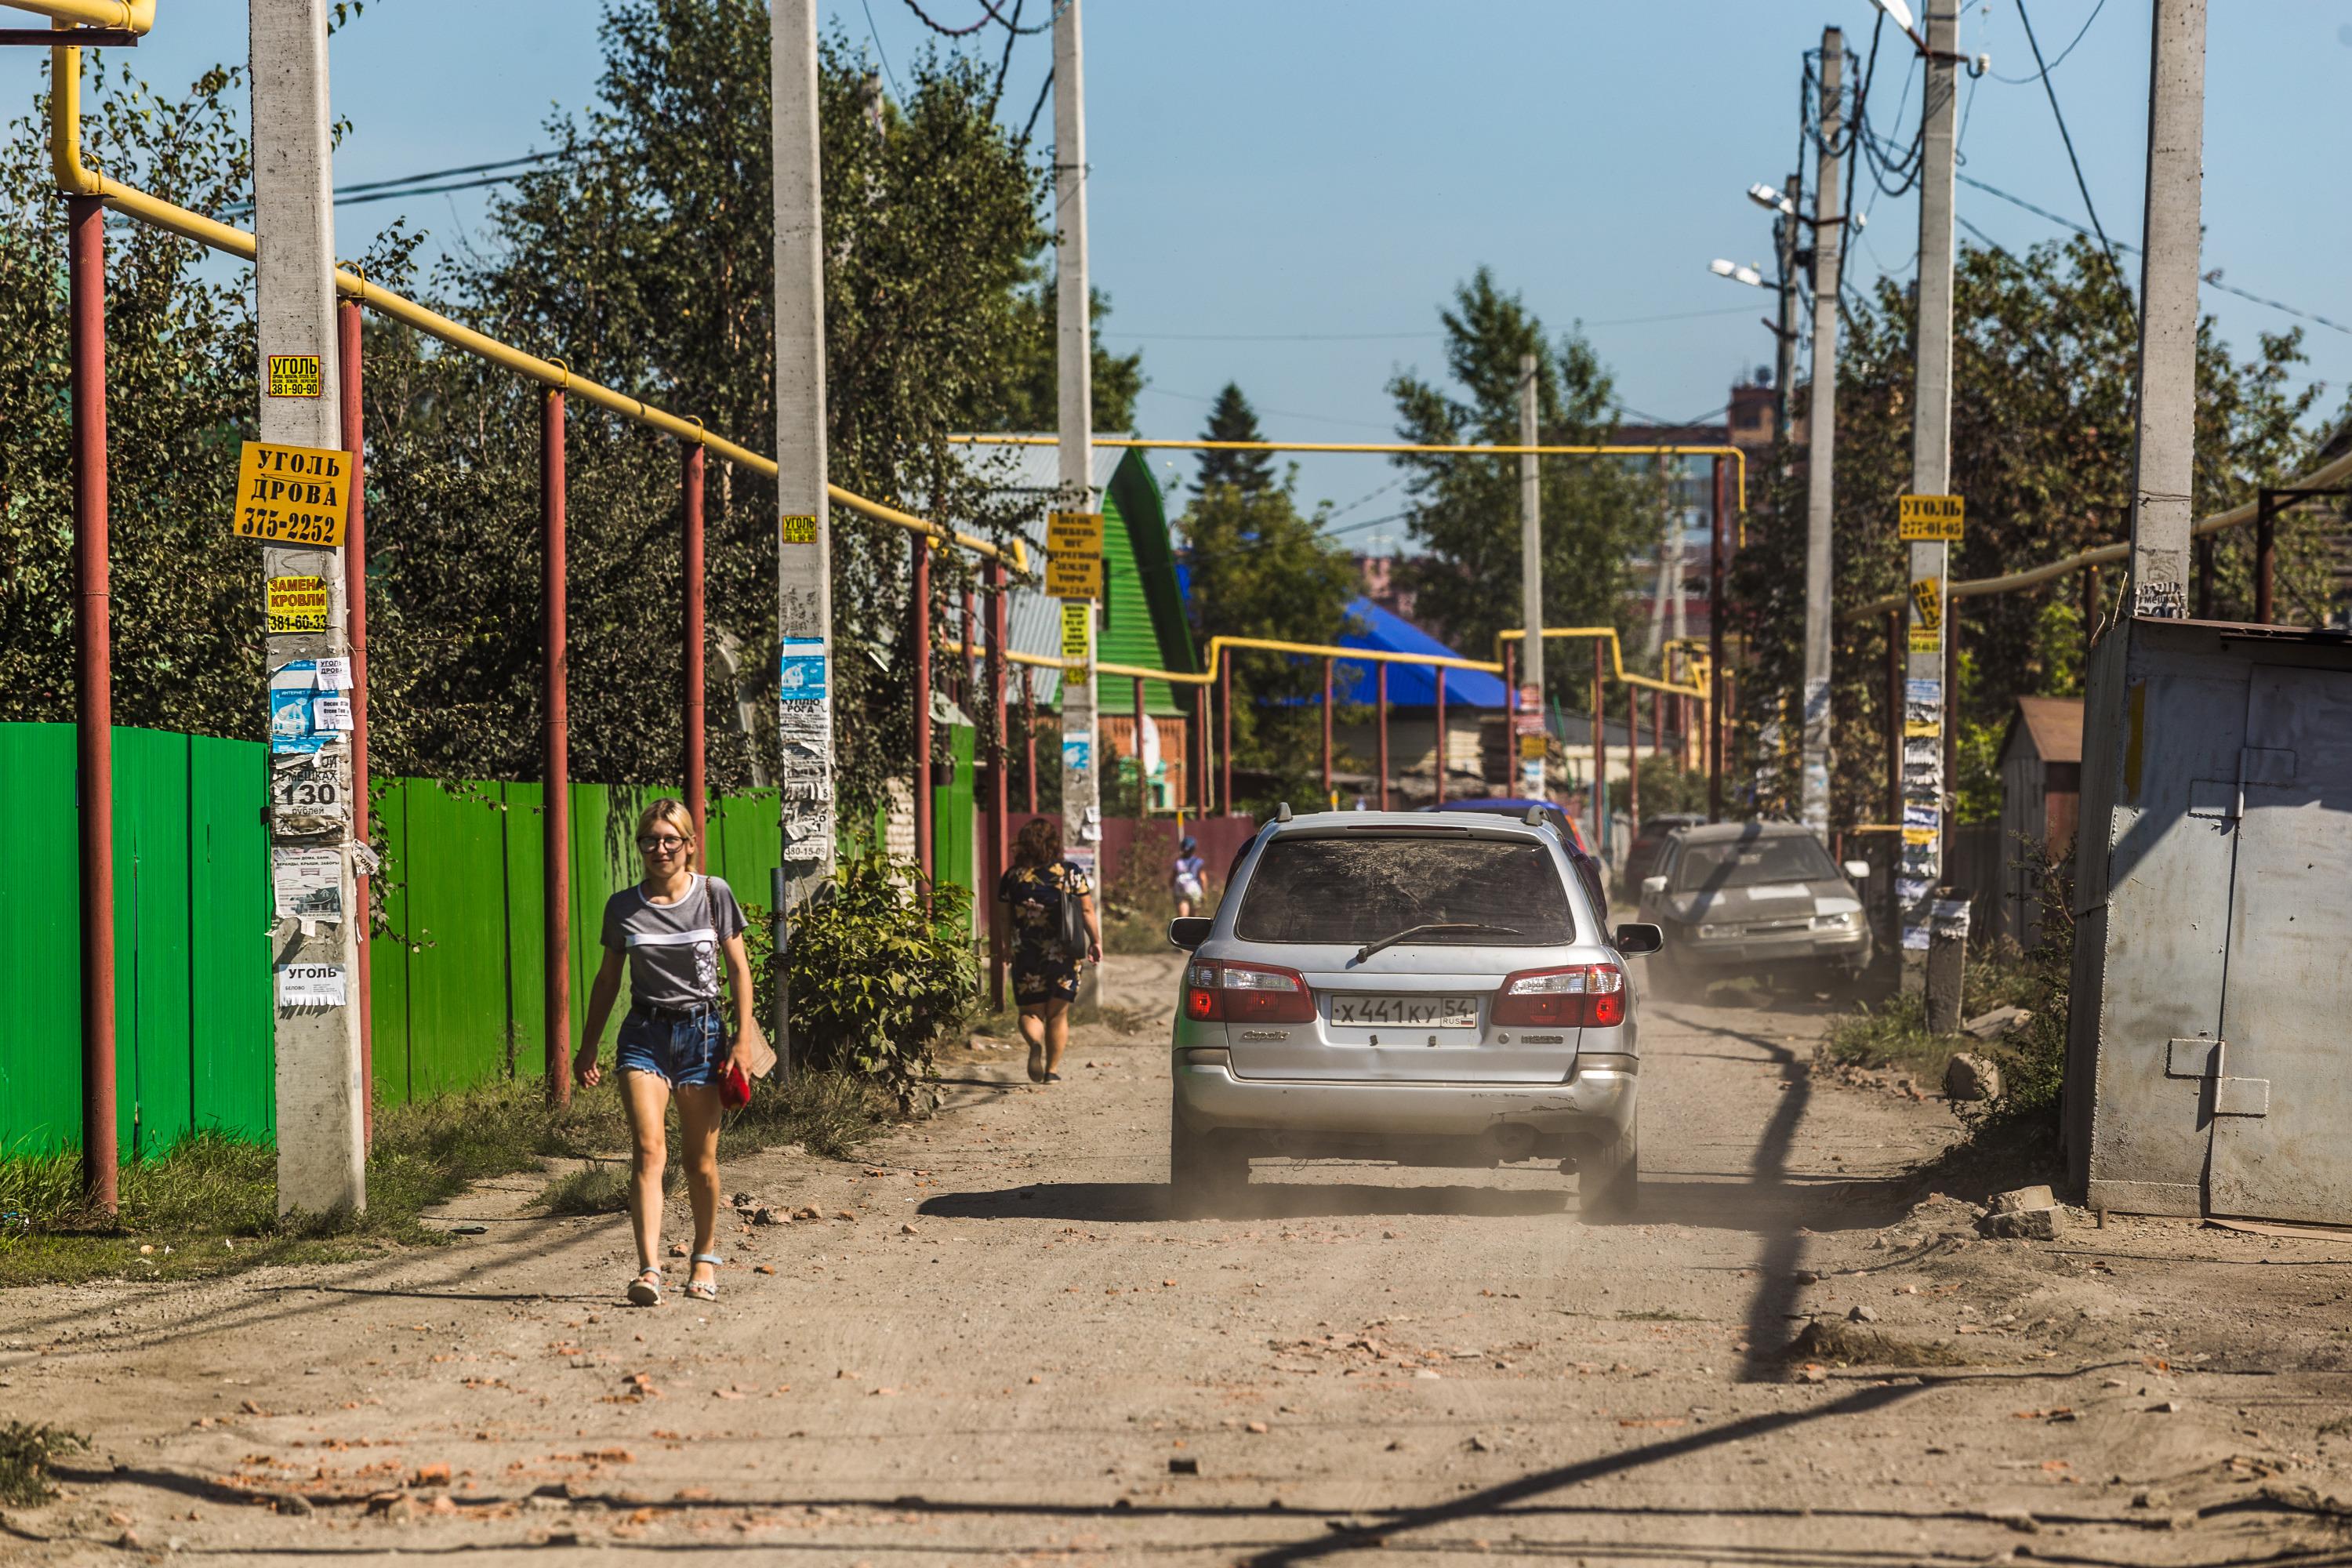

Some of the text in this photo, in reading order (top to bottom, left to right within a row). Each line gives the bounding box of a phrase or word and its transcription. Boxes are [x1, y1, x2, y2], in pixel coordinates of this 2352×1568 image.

[272, 358, 317, 374] УГОЛЬ
[272, 384, 318, 394] 381-90-90
[257, 449, 339, 477] УГОЛЬ
[251, 479, 337, 506] ДРОВА
[1903, 501, 1961, 516] УГОЛЬ
[241, 507, 335, 543] 375-2252
[785, 517, 815, 528] УГОЛЬ
[271, 593, 325, 607] КРОВЛИ
[270, 615, 326, 630] 381-60-33
[281, 784, 336, 806] 130
[292, 807, 325, 815] рублей
[289, 967, 337, 979] УГОЛЬ
[1445, 1000, 1468, 1018] 54
